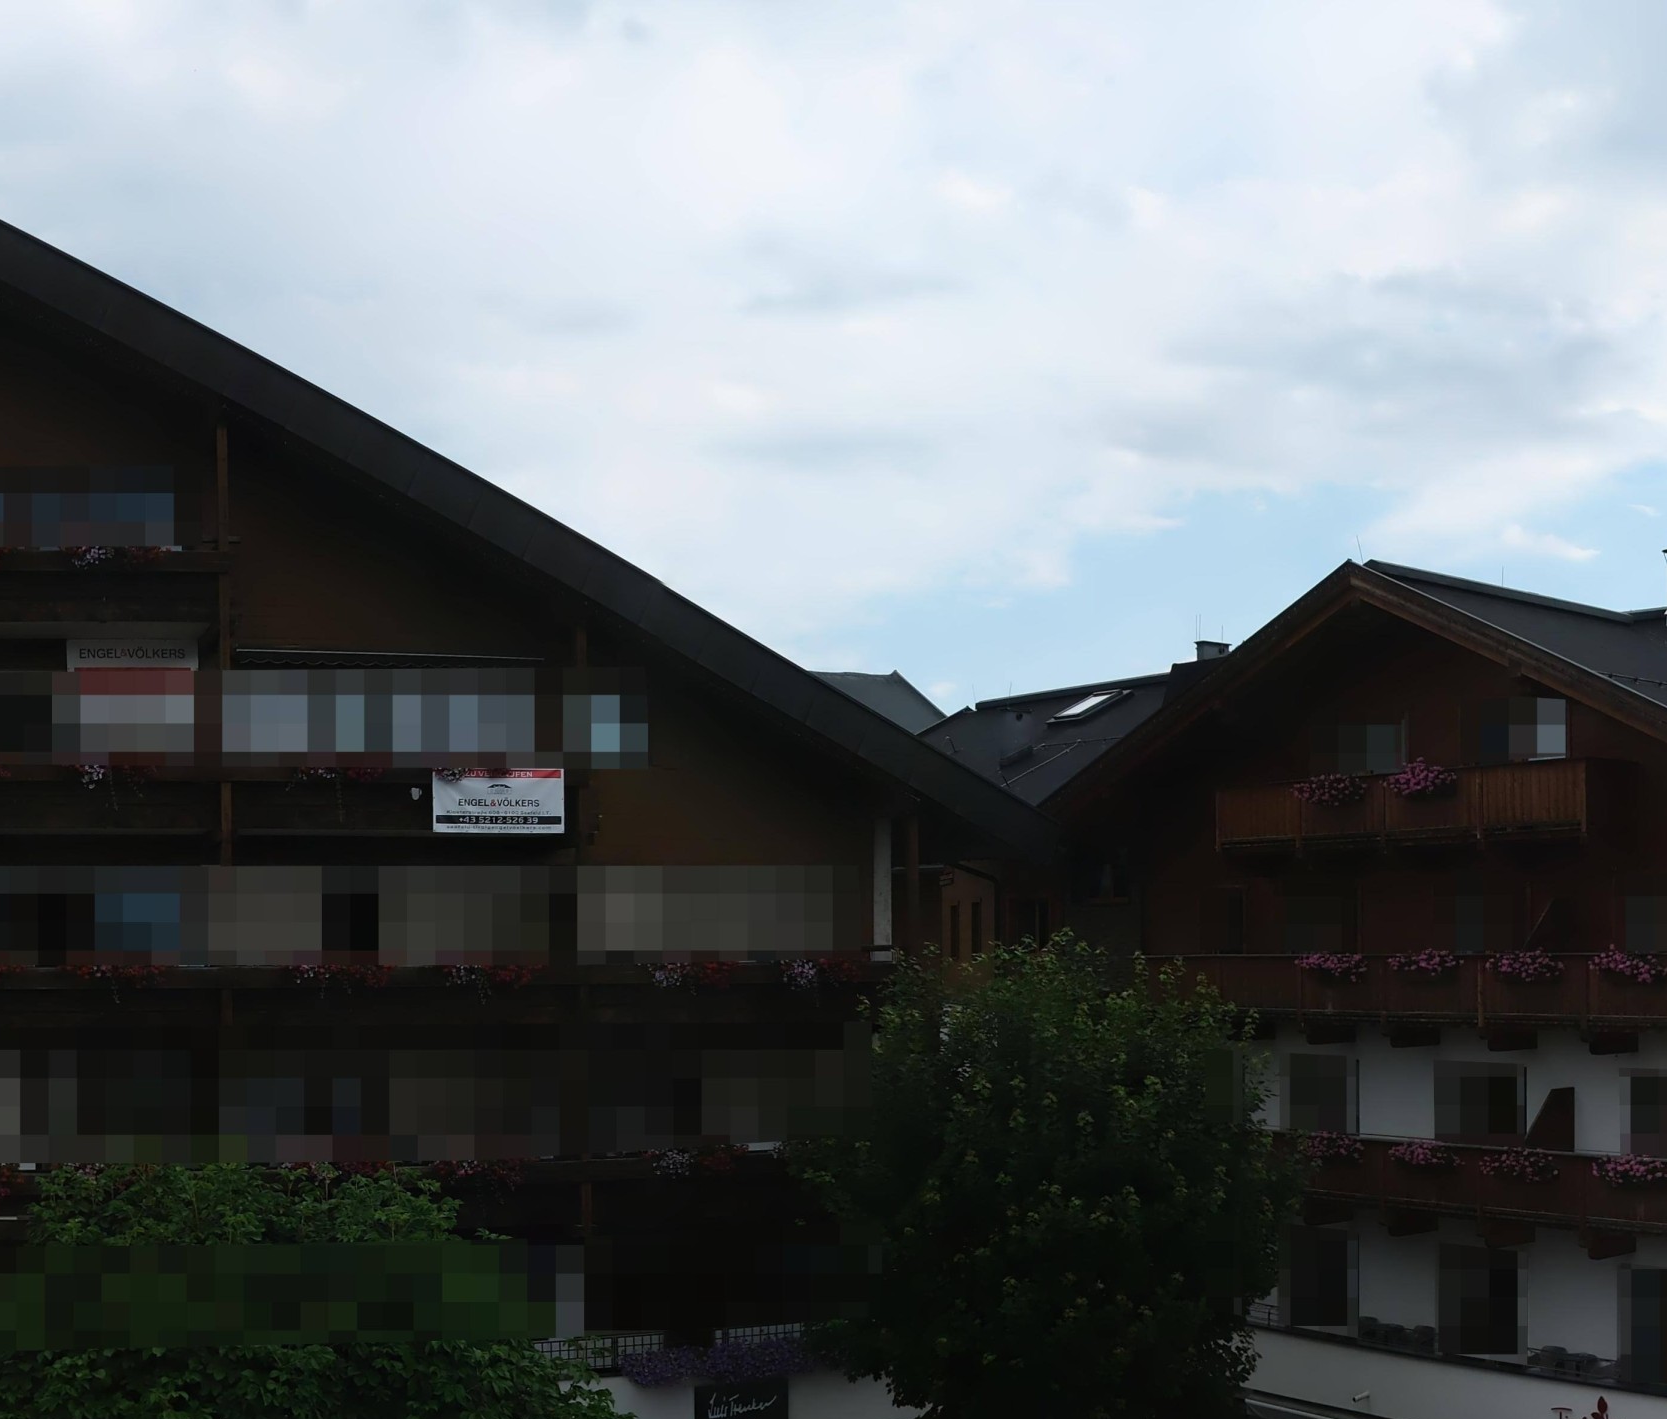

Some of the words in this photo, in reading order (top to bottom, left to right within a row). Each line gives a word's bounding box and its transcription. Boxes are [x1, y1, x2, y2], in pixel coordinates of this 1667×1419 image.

[79, 646, 186, 660] ENGEL&VÖLKERS
[458, 797, 540, 807] ENGEL&VÖLKERS
[459, 816, 476, 824] +43
[478, 816, 523, 824] 5212-526
[525, 816, 538, 824] 39
